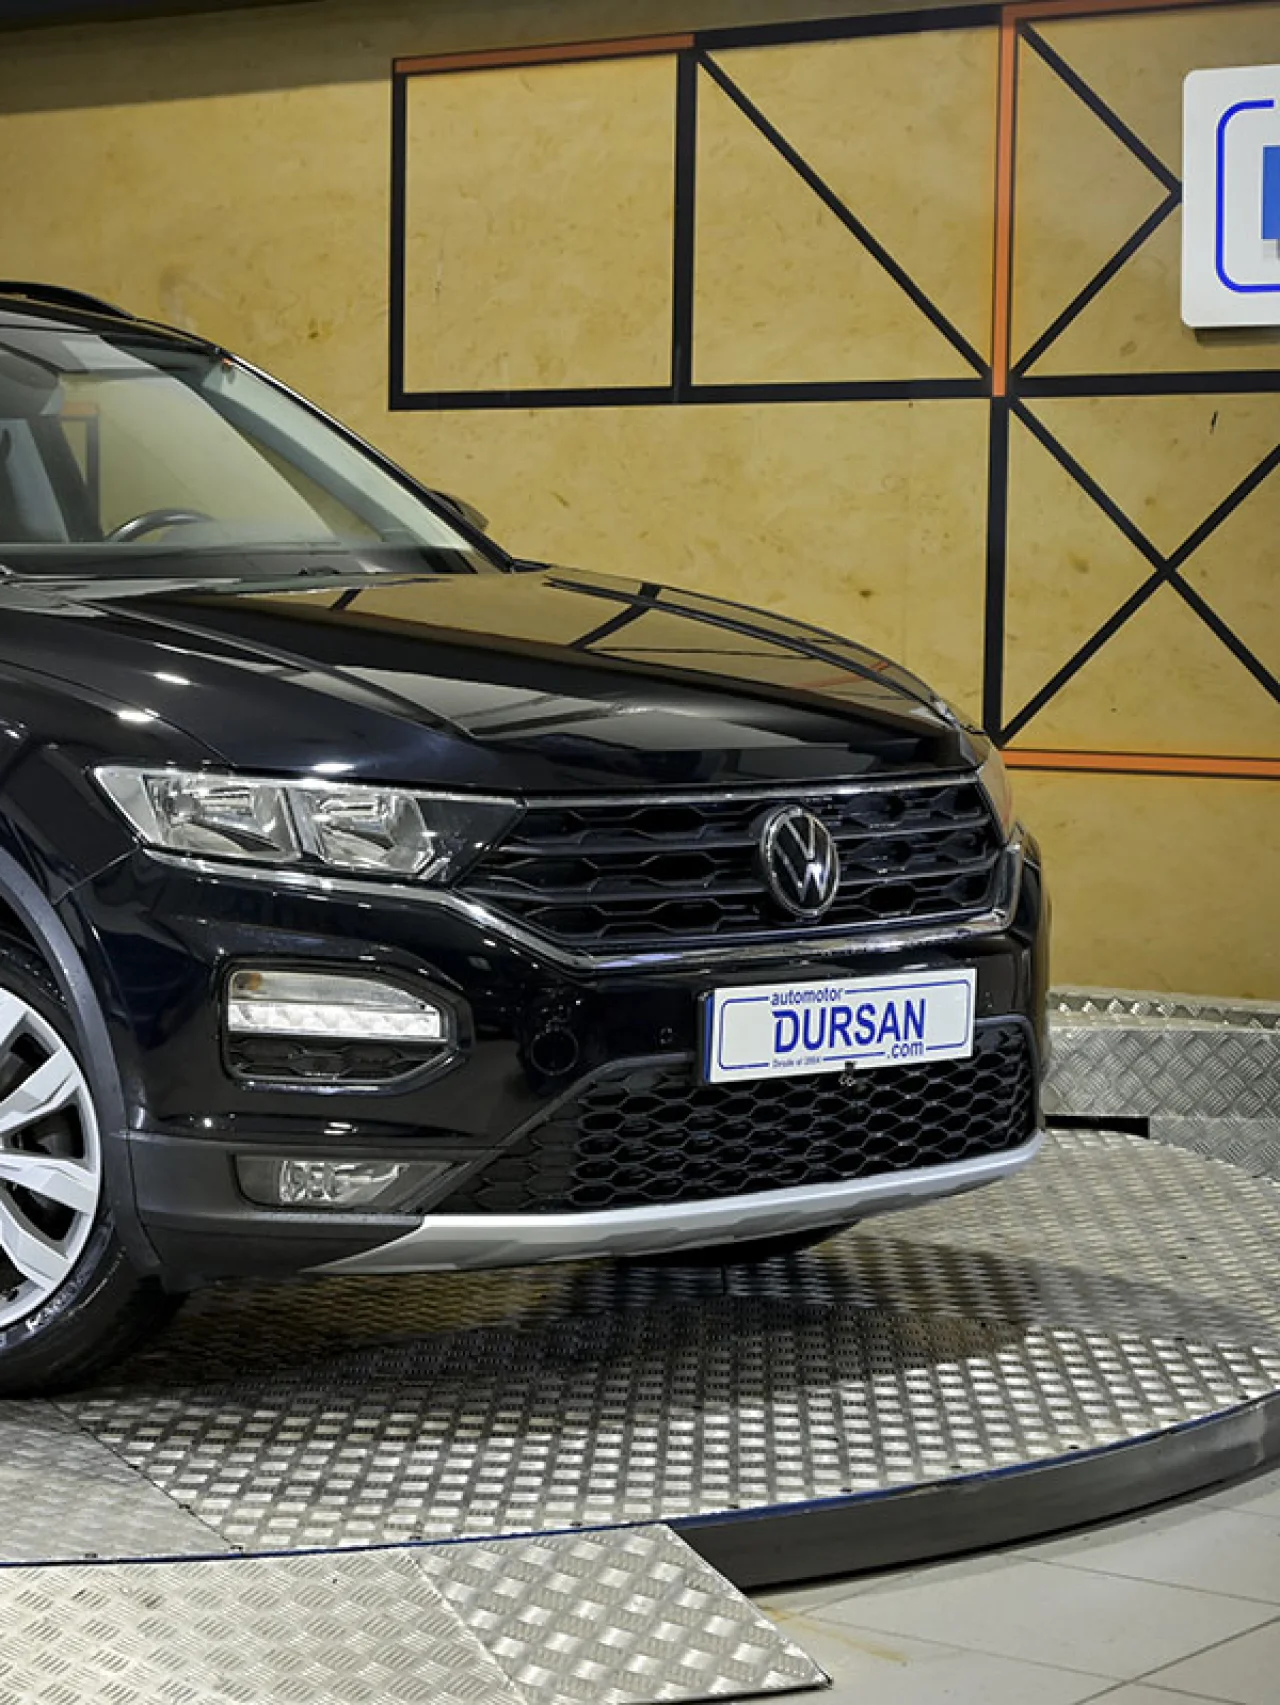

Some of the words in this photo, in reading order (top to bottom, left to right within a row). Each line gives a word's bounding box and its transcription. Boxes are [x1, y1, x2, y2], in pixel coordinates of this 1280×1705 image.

[771, 987, 844, 1007] automotor
[771, 998, 926, 1053] DURSAN
[886, 1040, 925, 1059] .com
